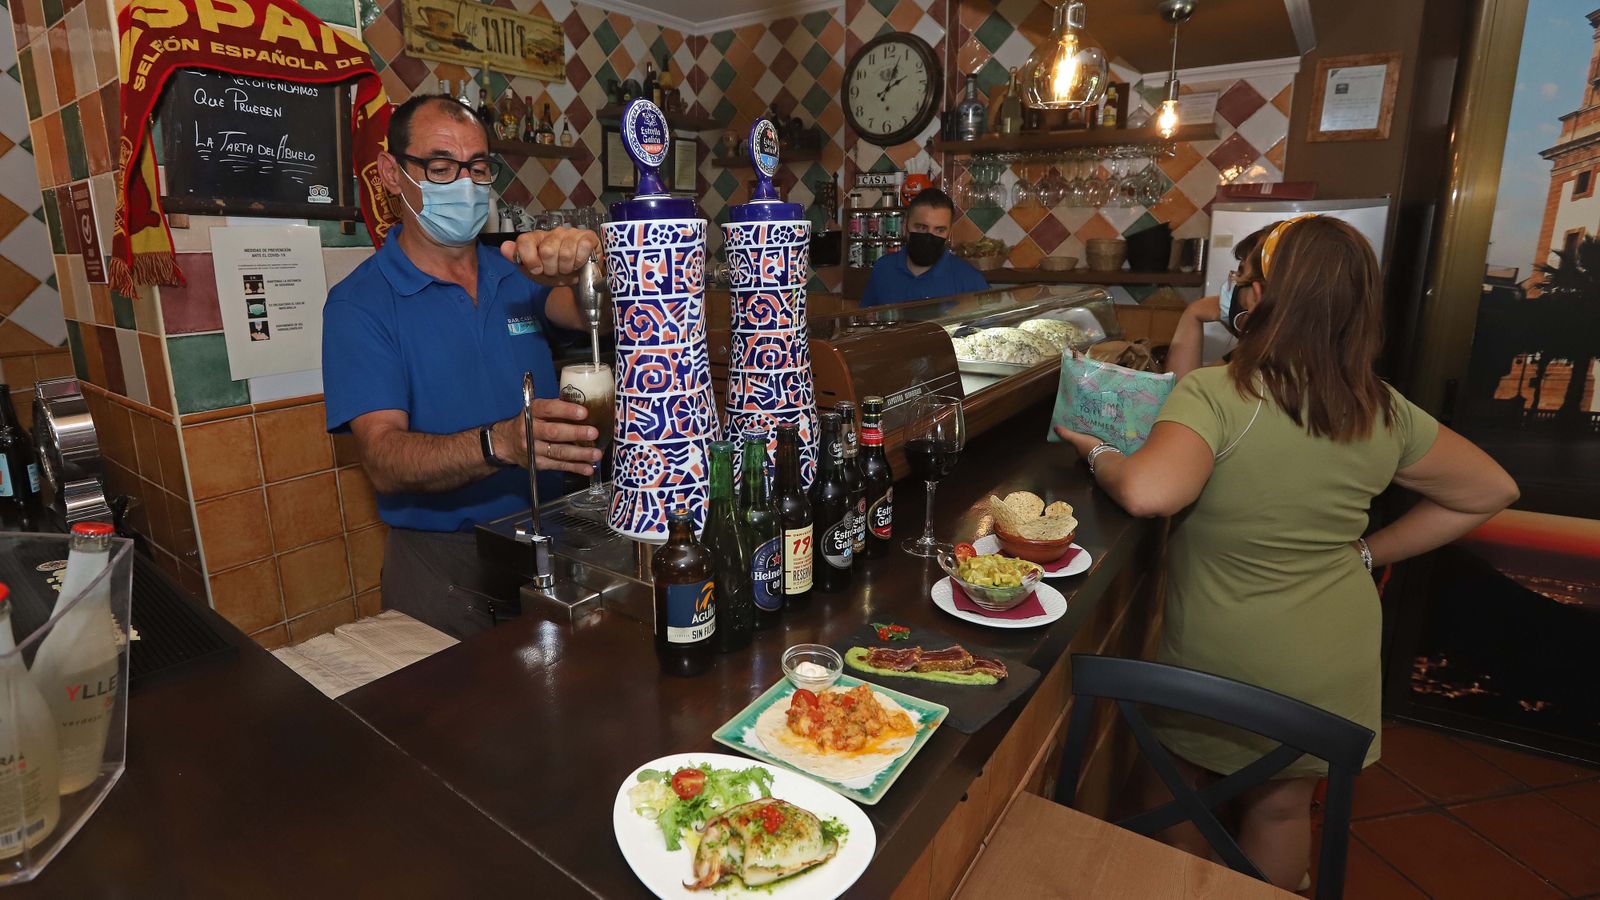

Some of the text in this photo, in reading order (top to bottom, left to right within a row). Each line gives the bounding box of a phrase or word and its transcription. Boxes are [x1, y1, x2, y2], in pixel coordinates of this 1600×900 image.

[210, 41, 328, 71] ESPAÑOLA
[335, 56, 364, 69] DE
[883, 44, 896, 59] 12
[905, 49, 909, 61] 1
[868, 53, 875, 65] 11
[915, 62, 923, 73] 2
[856, 69, 867, 80] 10
[850, 85, 860, 98] 9
[855, 106, 864, 117] 8
[868, 118, 874, 128] 7
[882, 120, 892, 133] 6
[902, 116, 908, 126] 5
[641, 126, 661, 136] Estrella
[195, 120, 316, 162] LA TARTA DEL ABUELO
[643, 135, 661, 143] Galicia
[862, 176, 887, 184] CASA
[691, 628, 703, 640] SIN
